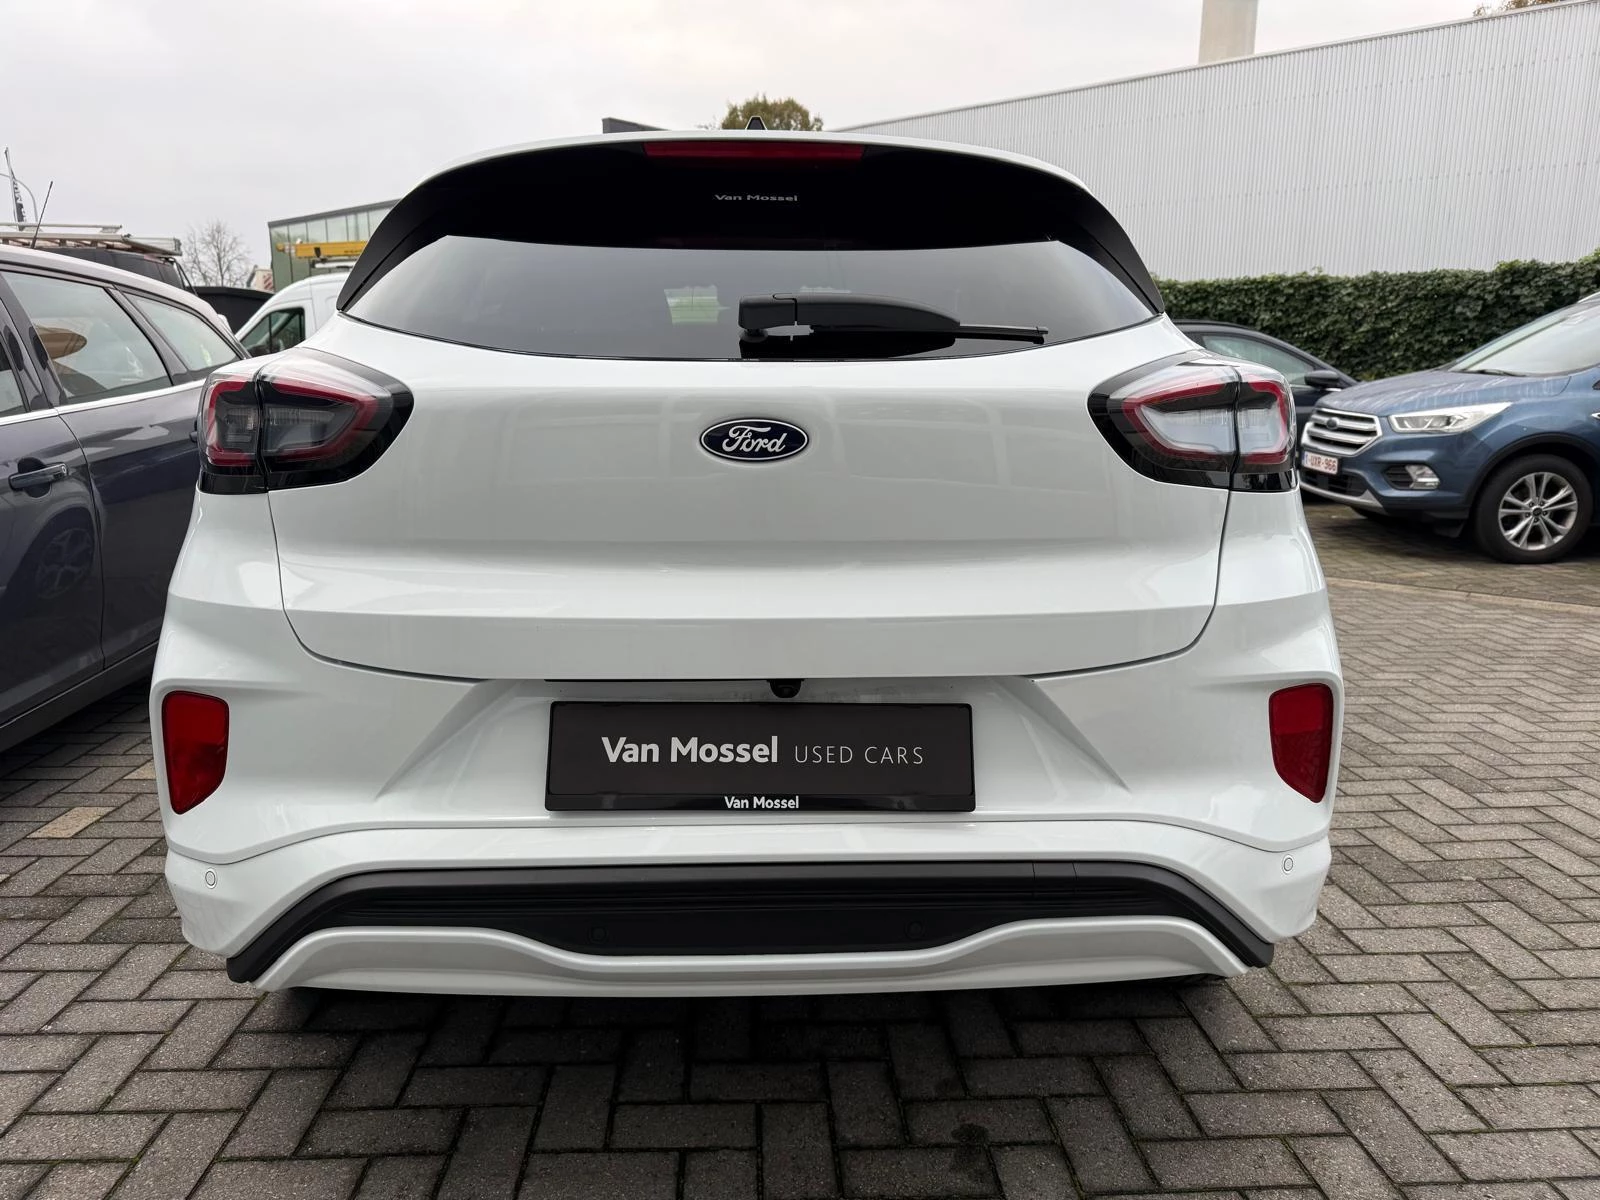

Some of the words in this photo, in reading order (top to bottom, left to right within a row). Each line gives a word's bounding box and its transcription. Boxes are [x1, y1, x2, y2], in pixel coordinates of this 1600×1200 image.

[746, 194, 798, 202] Mossel
[721, 425, 788, 453] Ford
[601, 736, 660, 763] Van
[670, 735, 778, 763] Mossel
[795, 745, 853, 764] USED
[864, 746, 923, 765] CARS
[724, 796, 749, 809] Van
[753, 796, 799, 809] Mossel
